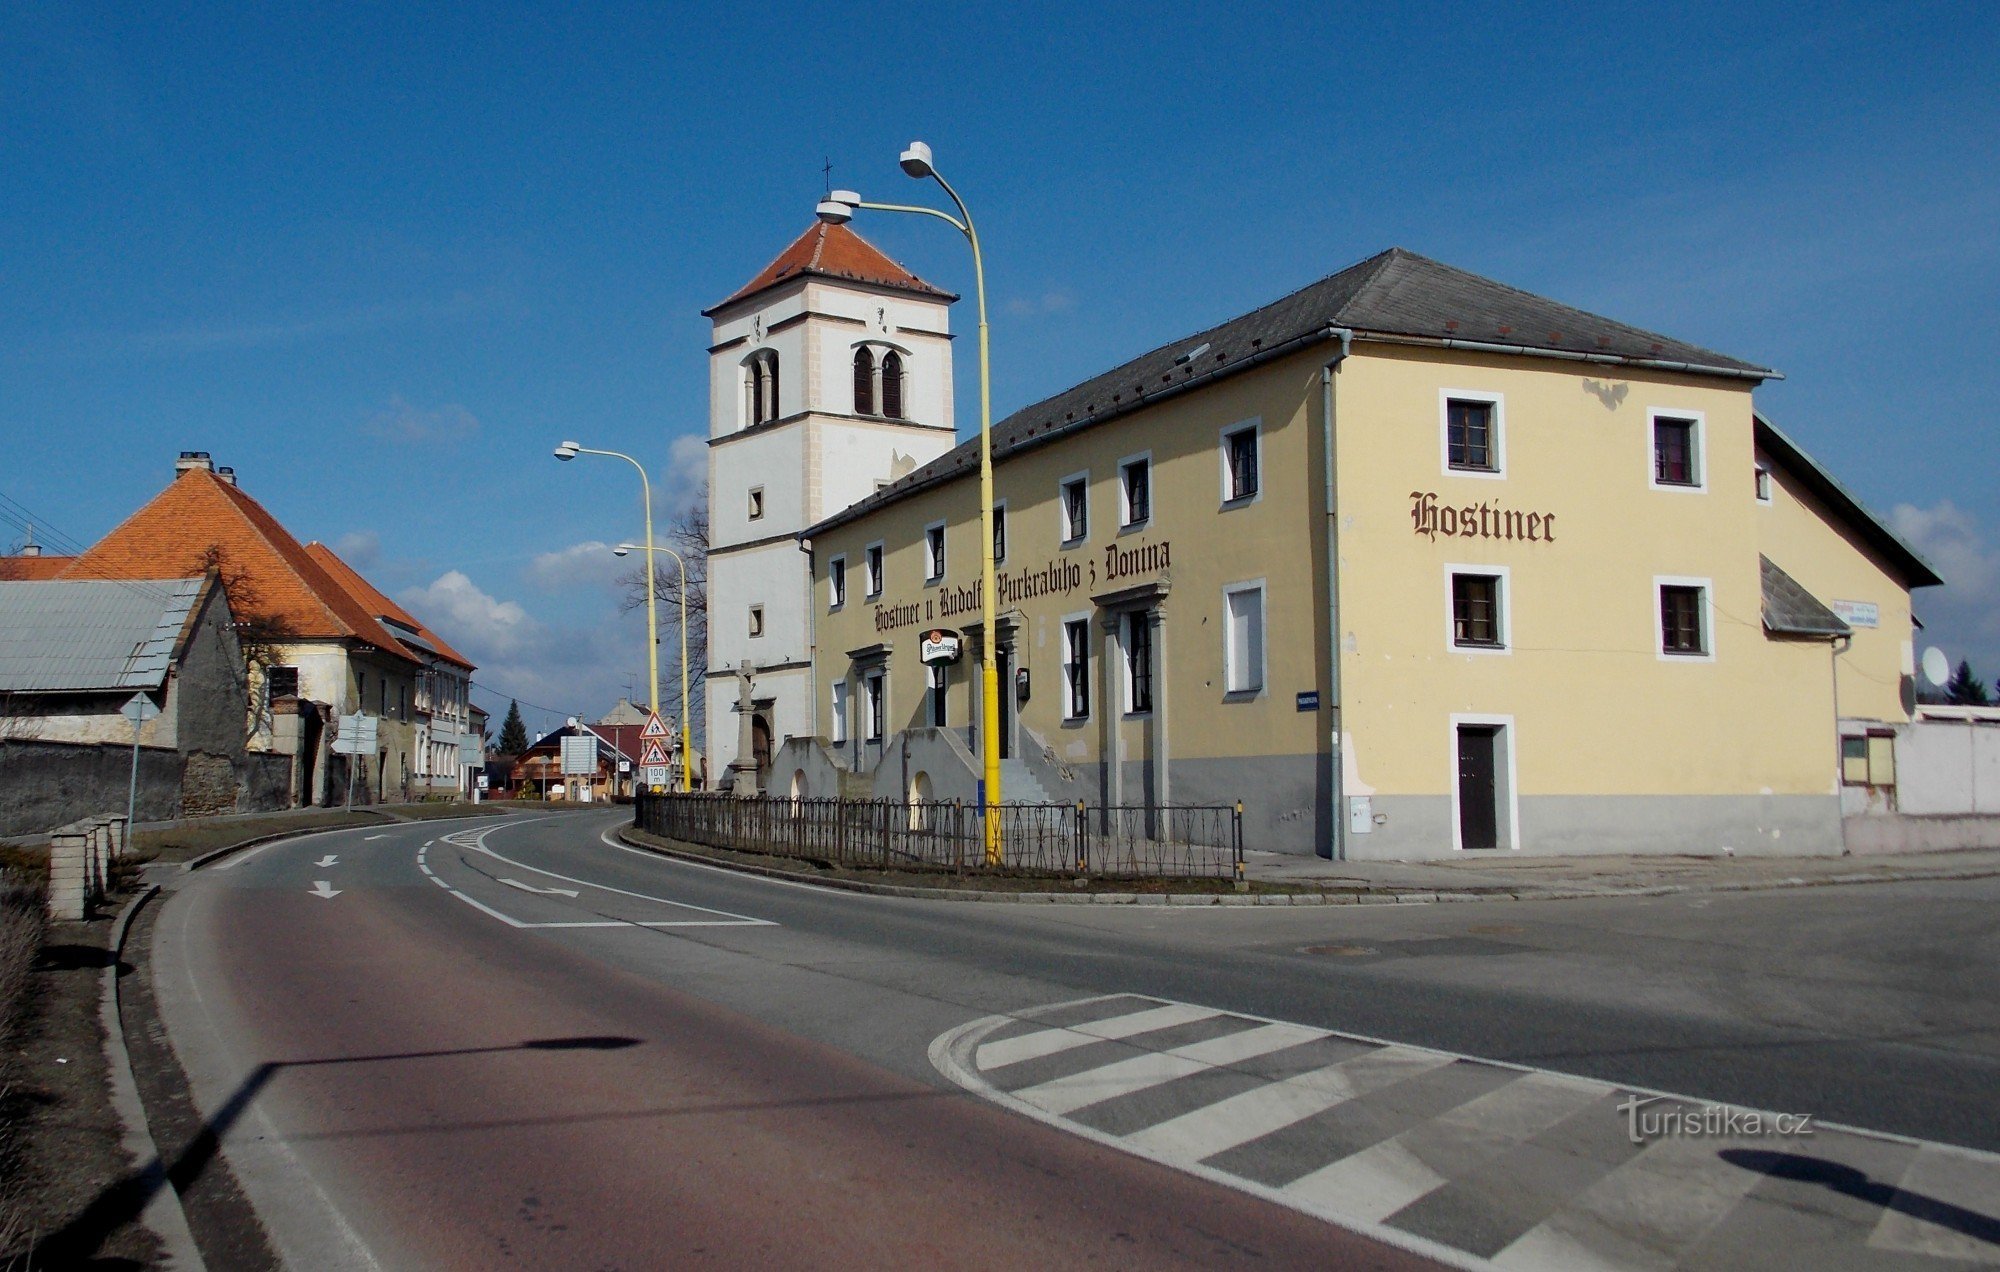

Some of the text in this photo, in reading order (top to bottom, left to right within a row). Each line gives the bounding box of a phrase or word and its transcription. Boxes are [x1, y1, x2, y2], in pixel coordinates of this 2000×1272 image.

[1409, 491, 1557, 543] Hostinec
[875, 599, 920, 635] Hostinec
[926, 599, 933, 621] u
[939, 578, 982, 618] Rudolf
[650, 768, 664, 777] 100
